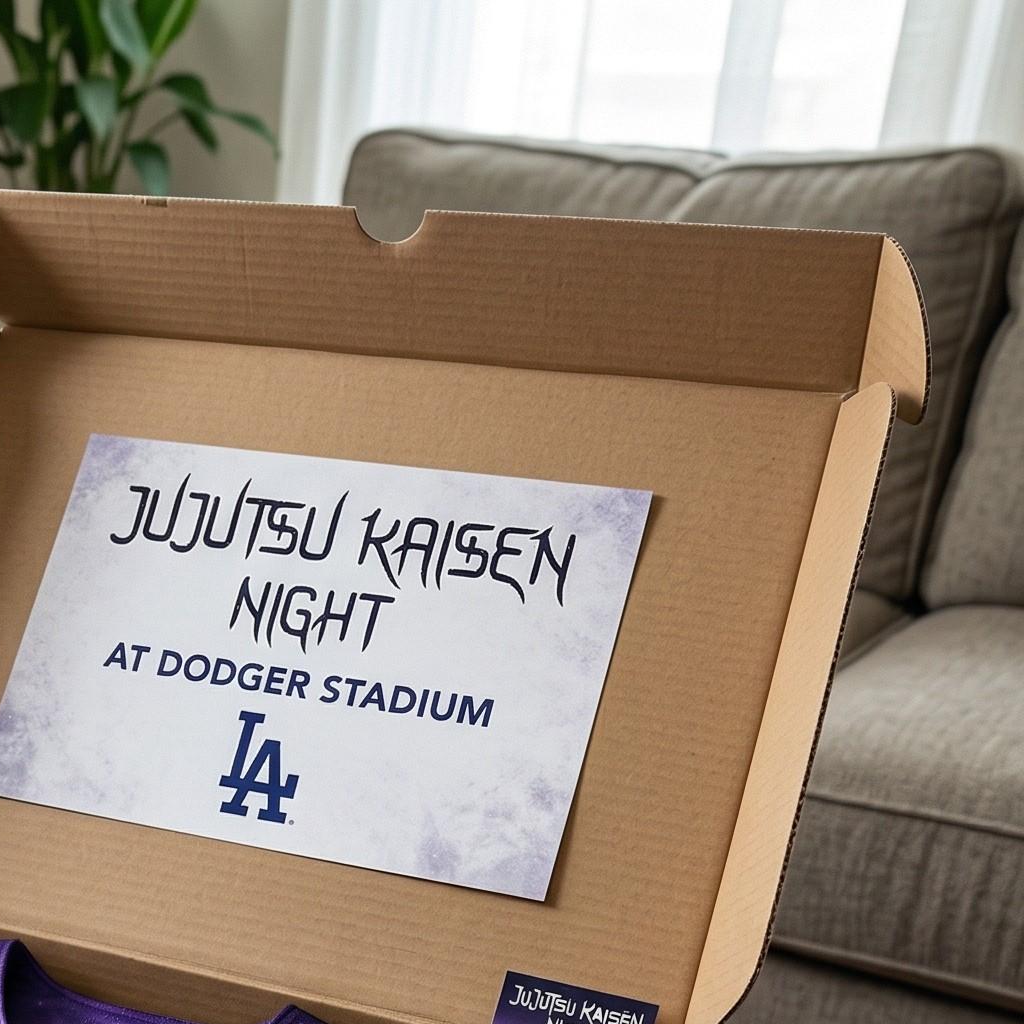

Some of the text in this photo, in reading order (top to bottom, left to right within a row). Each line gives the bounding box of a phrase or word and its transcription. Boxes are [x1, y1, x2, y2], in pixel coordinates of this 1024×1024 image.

[110, 473, 577, 607] JUJUTSU KAISEN
[229, 575, 395, 654] NIGHT
[103, 642, 495, 728] AT DODGER STADIUM
[219, 710, 299, 824] LA
[508, 984, 577, 1017] JUJUTSU
